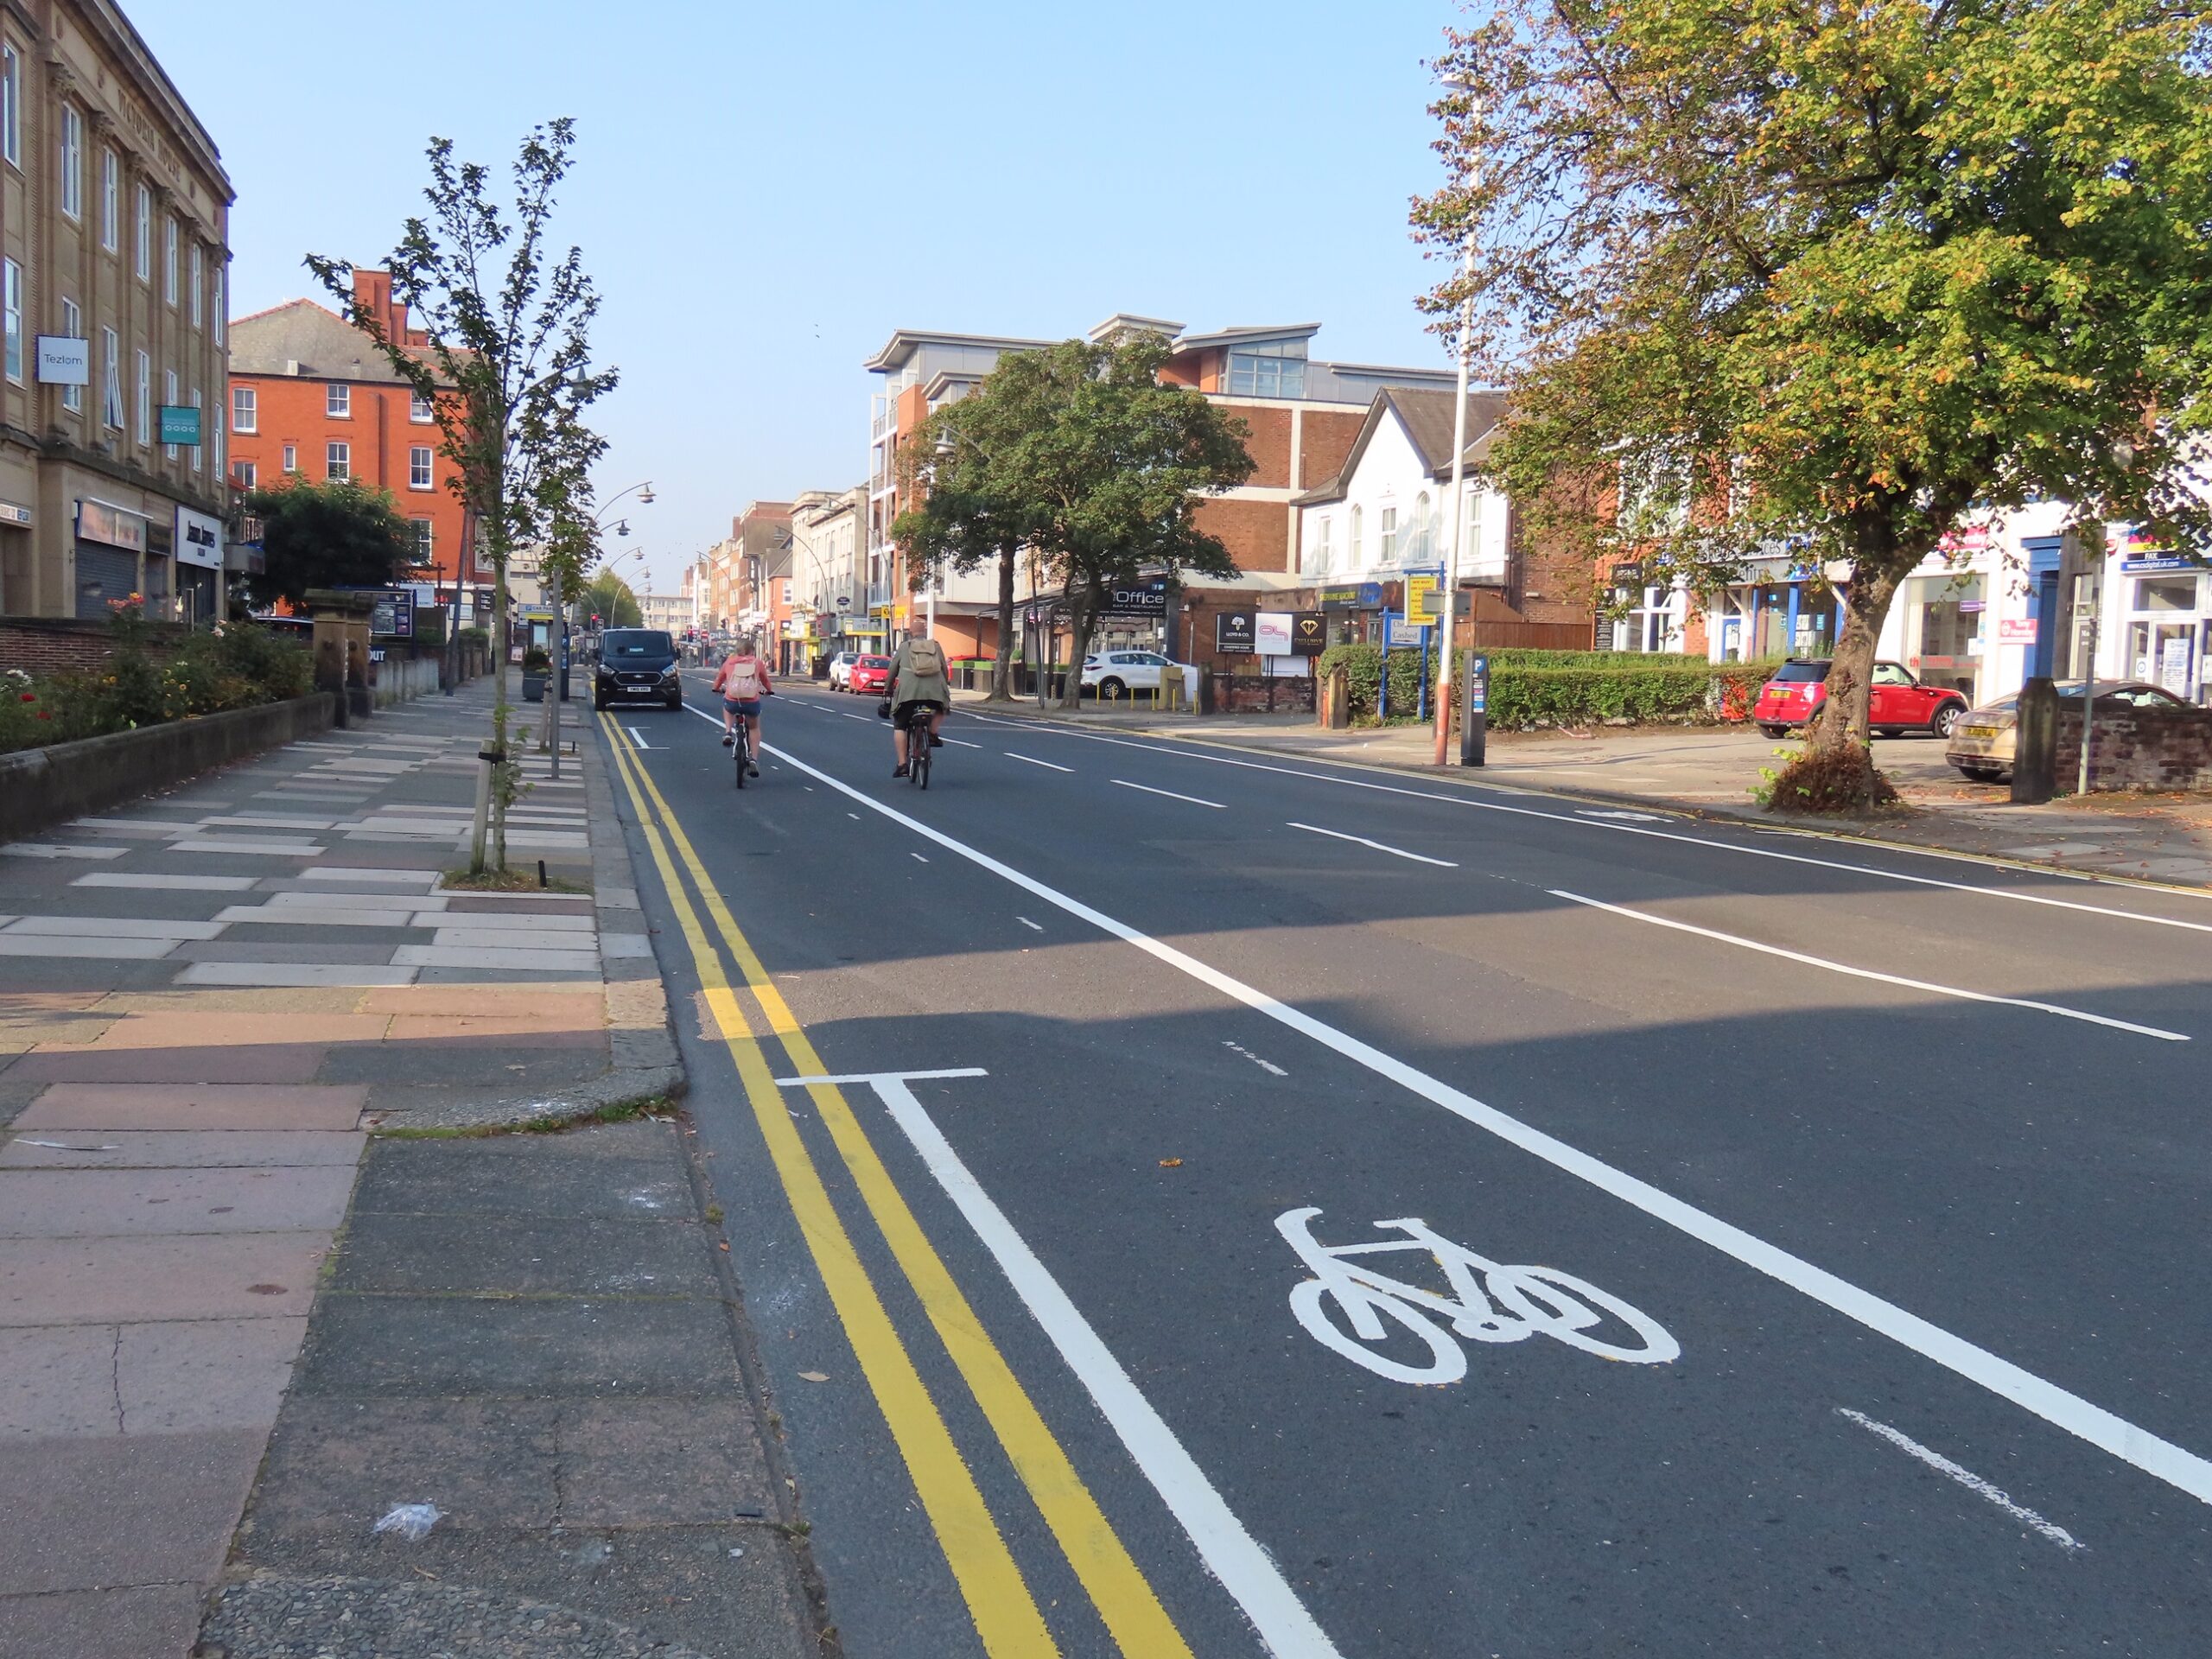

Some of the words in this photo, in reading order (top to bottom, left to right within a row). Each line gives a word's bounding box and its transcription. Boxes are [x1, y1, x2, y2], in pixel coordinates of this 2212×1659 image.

[118, 88, 155, 152] VICTORIA
[158, 138, 180, 182] HOUSE
[44, 353, 82, 365] Tezlom
[1116, 591, 1164, 604] Office
[1475, 659, 1482, 671] P
